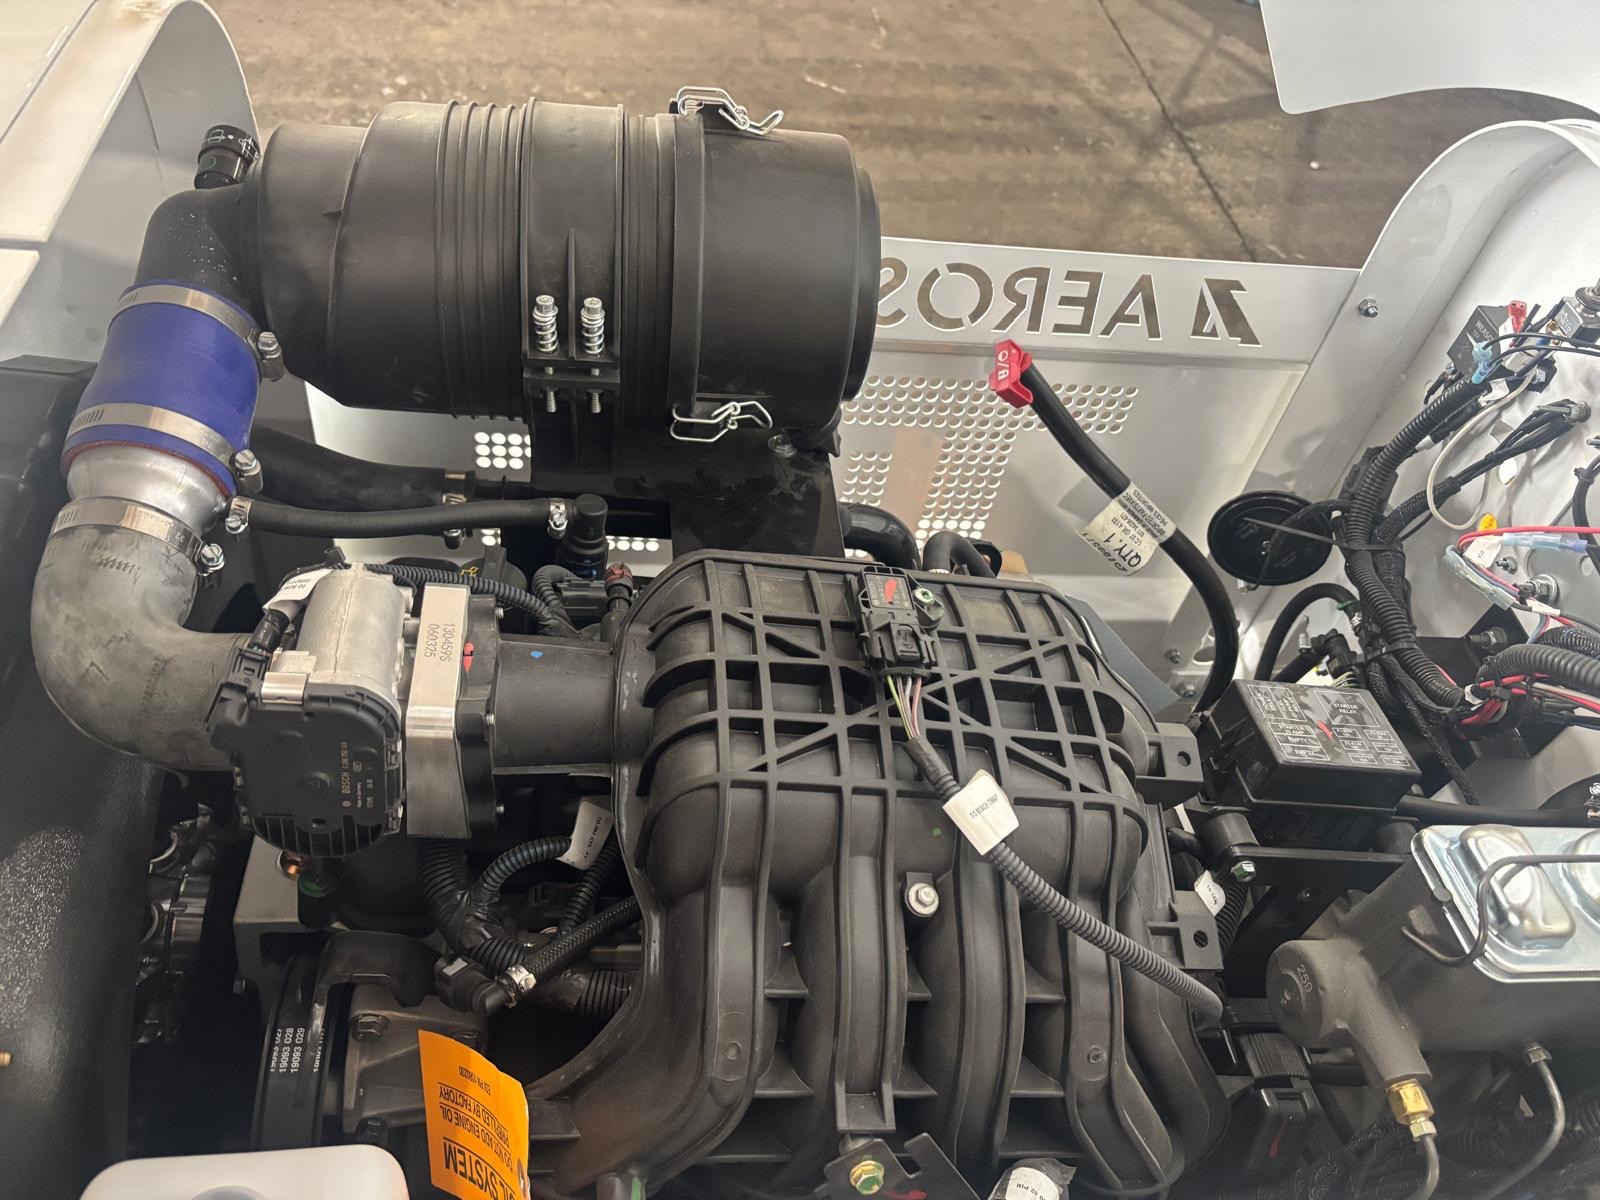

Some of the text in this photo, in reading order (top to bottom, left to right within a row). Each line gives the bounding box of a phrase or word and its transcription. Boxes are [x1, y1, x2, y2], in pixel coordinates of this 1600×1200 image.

[1104, 533, 1142, 567] QTY. 1
[424, 624, 440, 658] 060325
[440, 623, 456, 661] 130459S
[341, 772, 351, 794] BOSCH
[1297, 964, 1312, 992] 259
[279, 1028, 294, 1074] 19093 028
[290, 1028, 305, 1074] 19093 029
[439, 1085, 472, 1110] FACTORY
[472, 1102, 481, 1118] BY
[439, 1105, 453, 1122] OIL
[454, 1111, 480, 1139] ENGINE
[481, 1128, 493, 1148] ADD
[443, 1141, 498, 1200] SYSTEM
